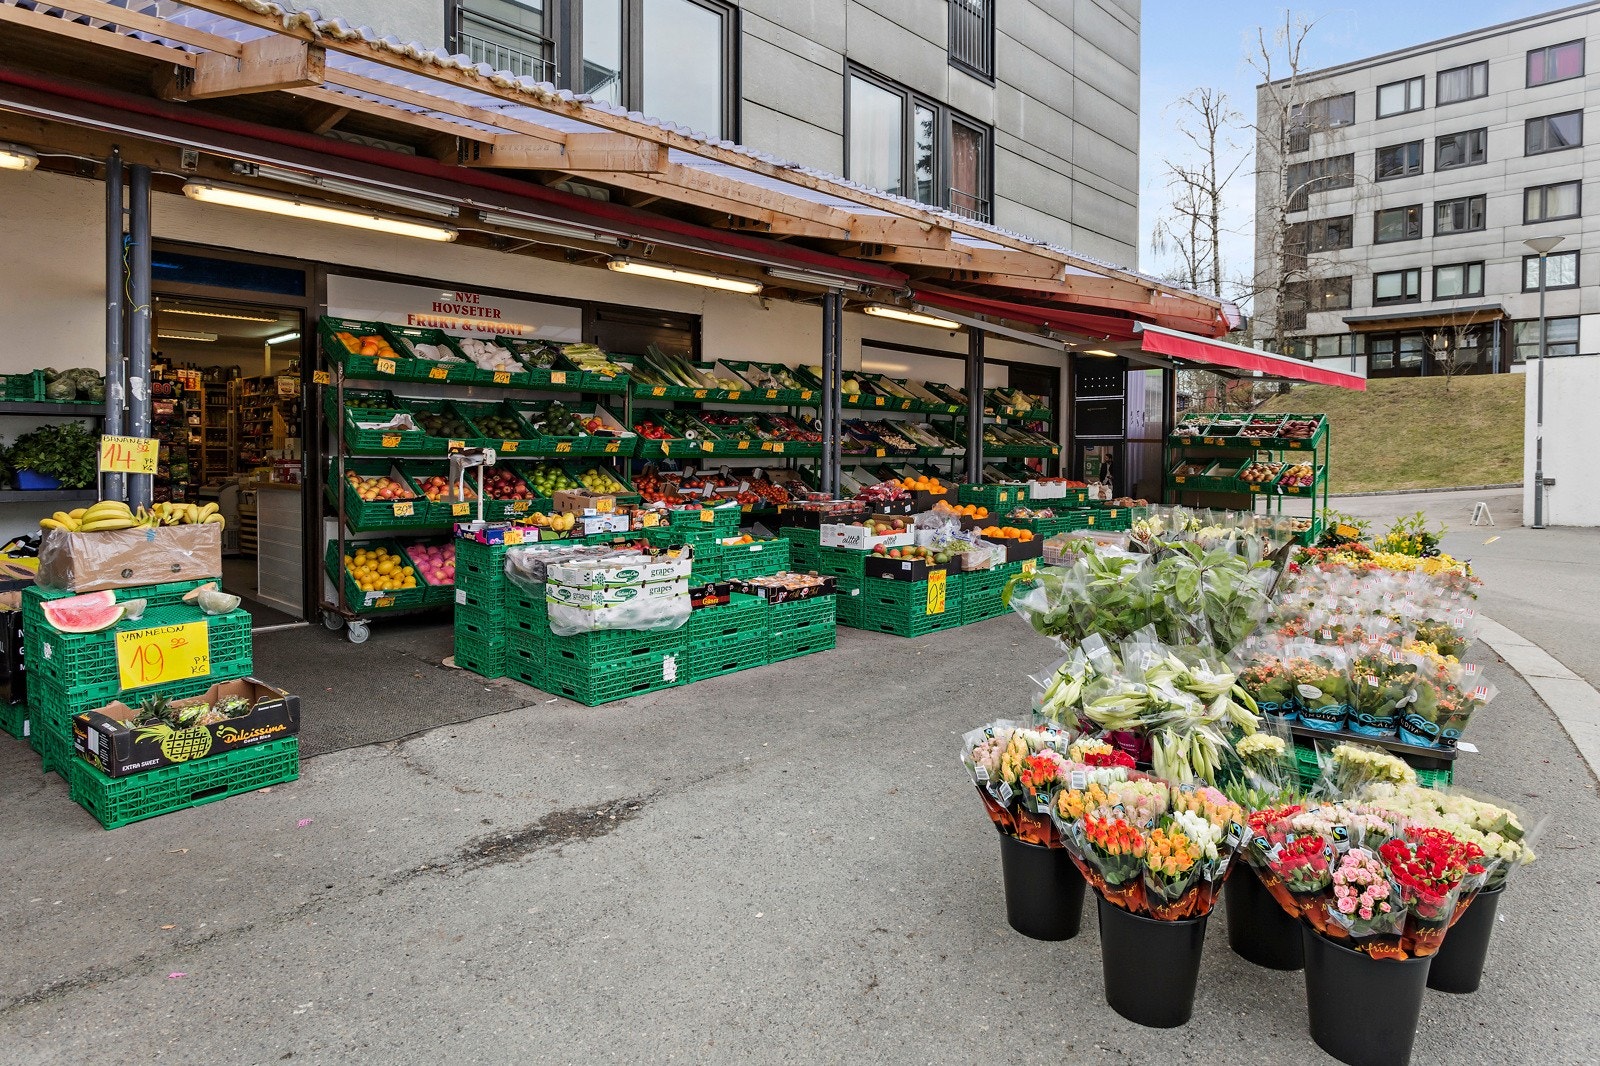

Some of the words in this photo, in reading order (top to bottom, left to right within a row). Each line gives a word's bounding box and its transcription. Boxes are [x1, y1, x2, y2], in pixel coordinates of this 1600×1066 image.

[455, 291, 480, 304] NYE
[432, 302, 501, 319] HOVSETER
[407, 313, 457, 330] FRUKT
[461, 320, 473, 332] &
[476, 321, 524, 336] GRØNT
[103, 435, 150, 446] BANANER
[103, 443, 136, 469] 14
[650, 566, 675, 577] grapes
[649, 584, 673, 595] grapes
[130, 643, 164, 682] 19
[222, 724, 287, 744] Dulcissima
[122, 762, 141, 772] EXTRA
[141, 758, 160, 768] SWEET
